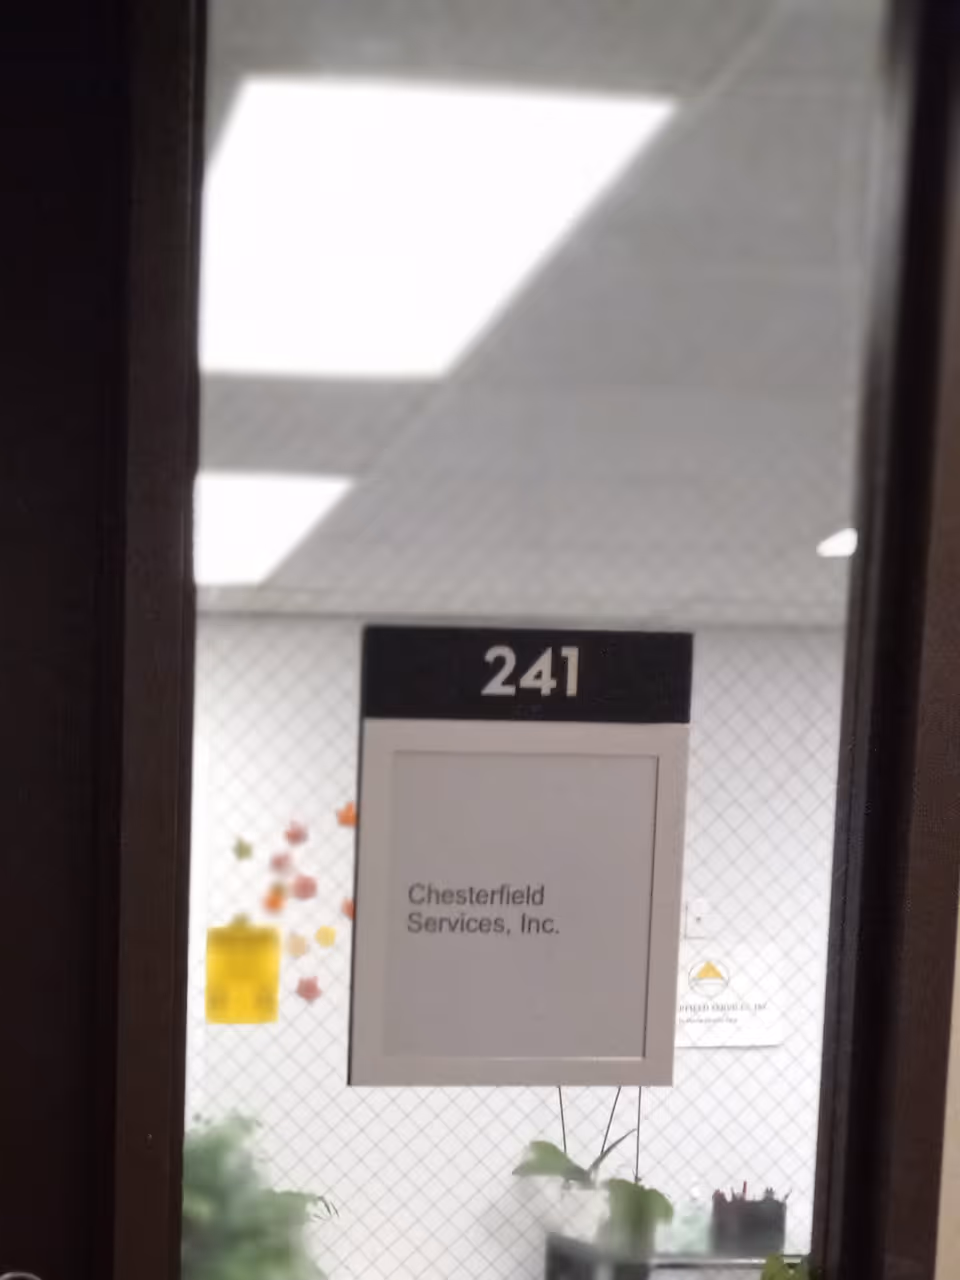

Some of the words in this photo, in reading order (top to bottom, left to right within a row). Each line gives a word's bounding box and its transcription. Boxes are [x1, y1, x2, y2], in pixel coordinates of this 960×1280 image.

[481, 645, 579, 697] 241
[407, 882, 545, 906] Chesterfield
[407, 911, 511, 936] Services,
[520, 912, 560, 935] Inc.
